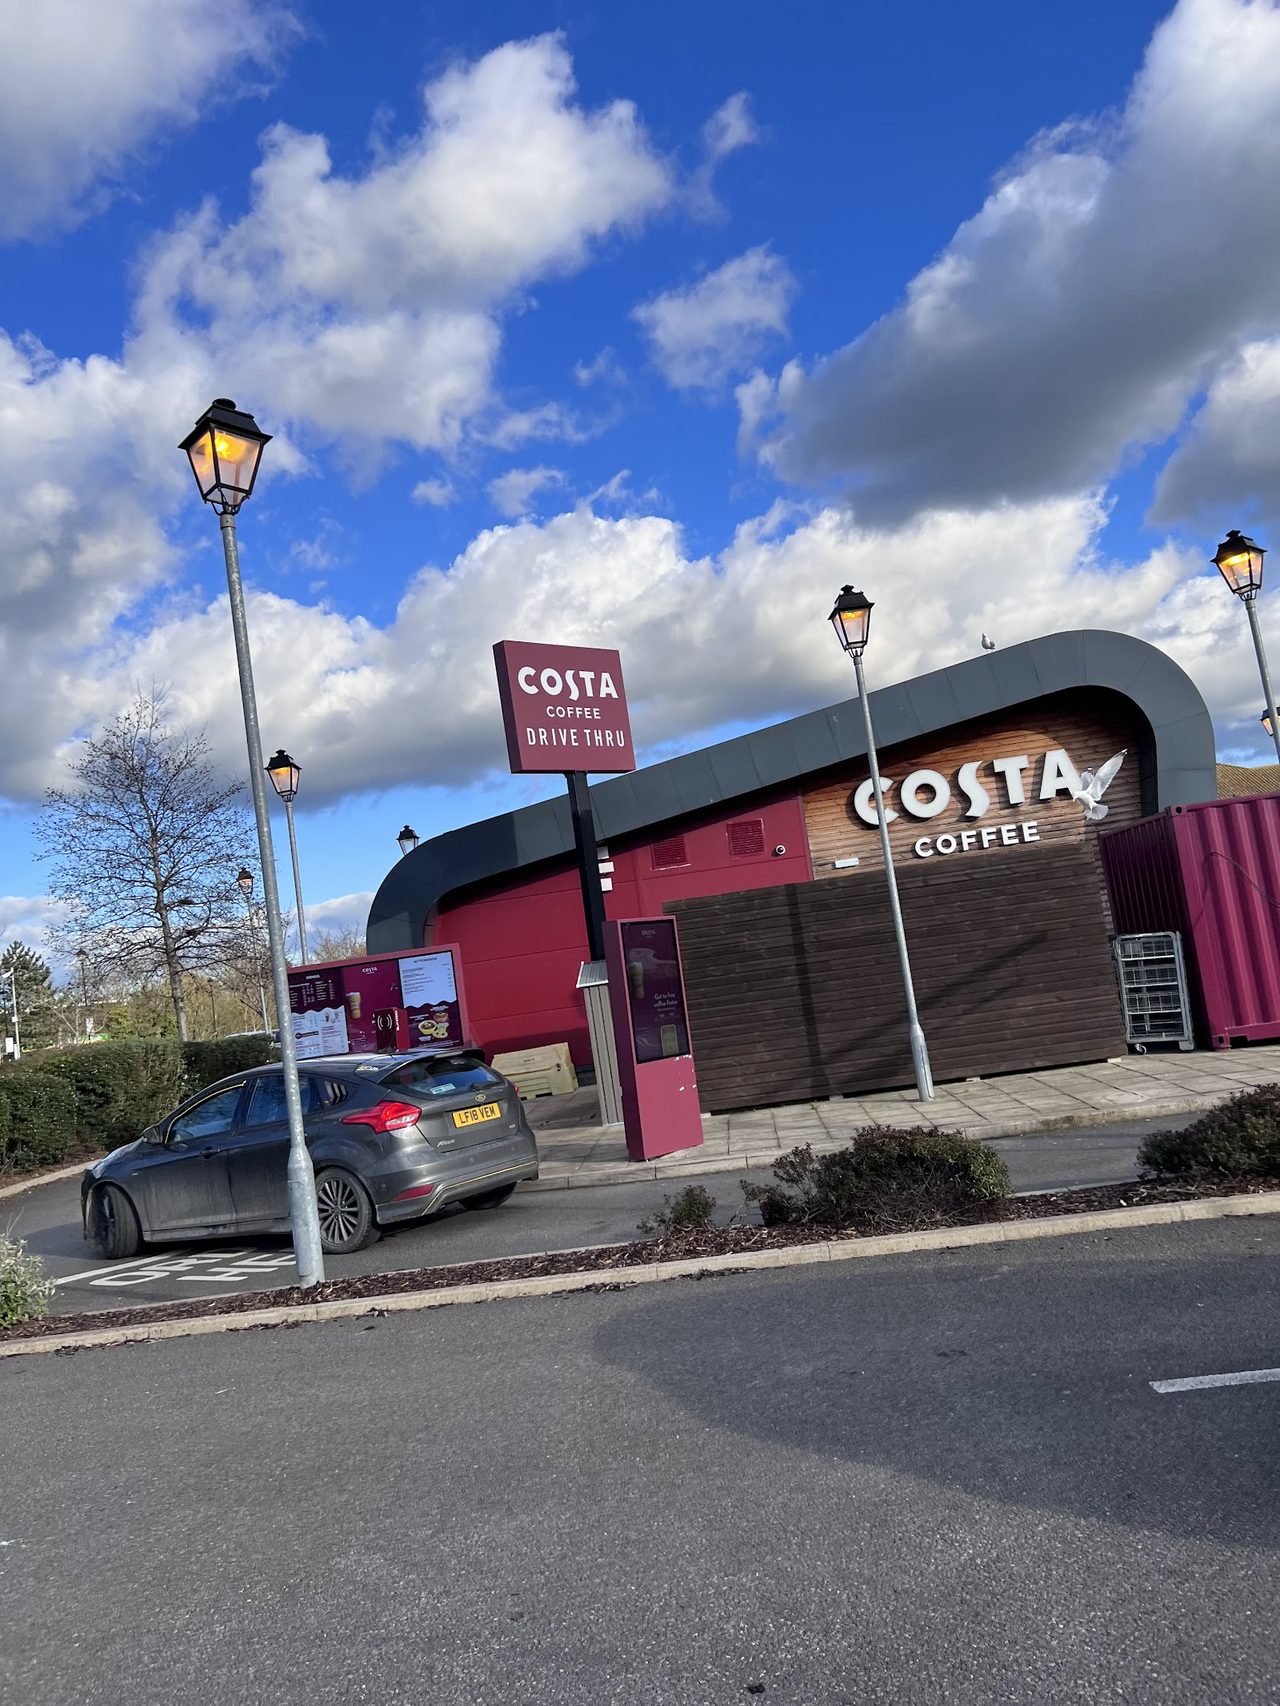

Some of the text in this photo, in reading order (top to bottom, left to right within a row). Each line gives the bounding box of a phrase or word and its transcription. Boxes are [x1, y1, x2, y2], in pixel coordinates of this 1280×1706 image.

[517, 666, 619, 701] COSTA
[546, 705, 601, 719] COFFEE
[526, 727, 625, 748] DRIVE THRU
[854, 748, 1083, 825] COSTA
[914, 821, 1040, 858] COFFEE
[458, 1109, 479, 1124] LF18
